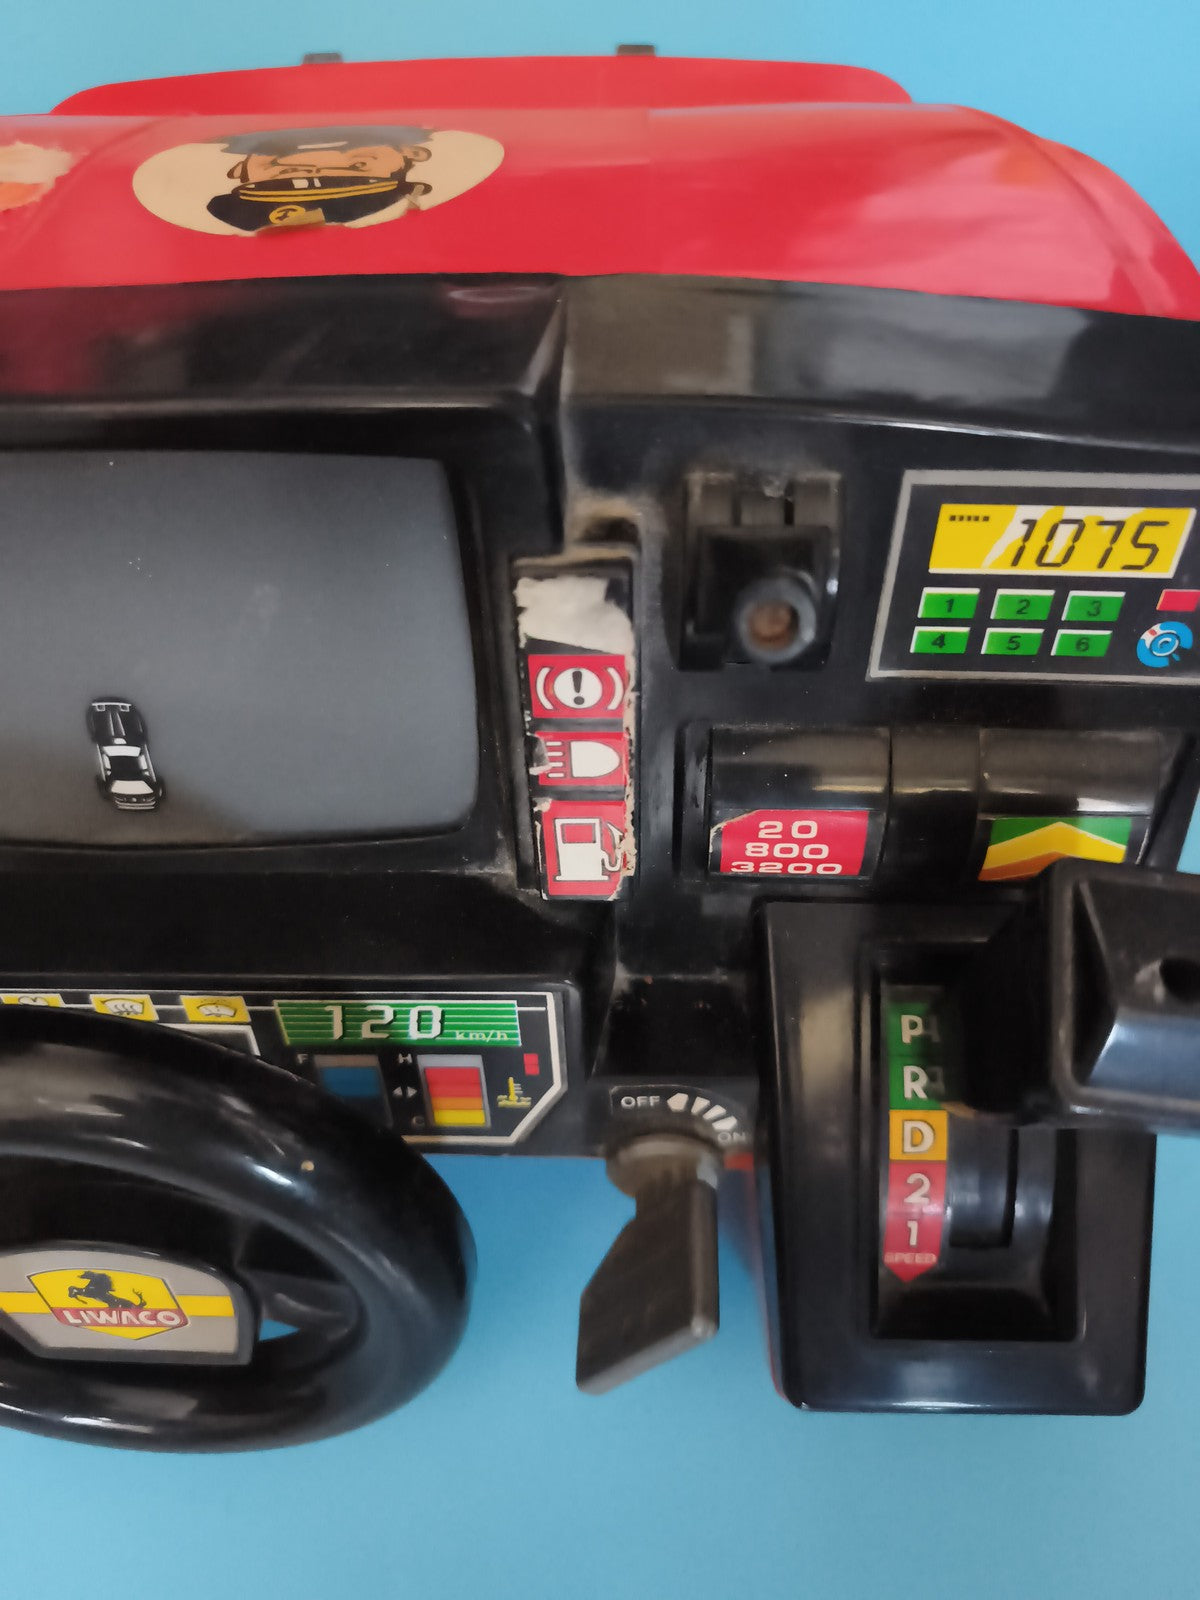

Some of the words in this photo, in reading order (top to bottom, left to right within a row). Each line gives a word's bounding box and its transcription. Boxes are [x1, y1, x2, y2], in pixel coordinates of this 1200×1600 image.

[1011, 518, 1170, 571] 1075
[945, 598, 955, 614] 1
[1016, 598, 1031, 616] 2
[1087, 600, 1102, 617] 3
[930, 633, 946, 649] 4
[1007, 634, 1022, 652] 5
[1075, 636, 1090, 652] 6
[745, 842, 829, 859] 800
[731, 861, 842, 875] 3200
[324, 1005, 443, 1040] 120
[901, 1014, 923, 1044] P
[398, 1053, 413, 1065] H
[903, 1065, 928, 1100] R
[621, 1096, 660, 1109] OFF
[717, 1131, 747, 1146] ON
[903, 1120, 935, 1154] D
[904, 1173, 930, 1205] 2
[907, 1220, 918, 1247] 1
[884, 1252, 937, 1264] SPEED
[62, 1308, 182, 1327] LIWACO
